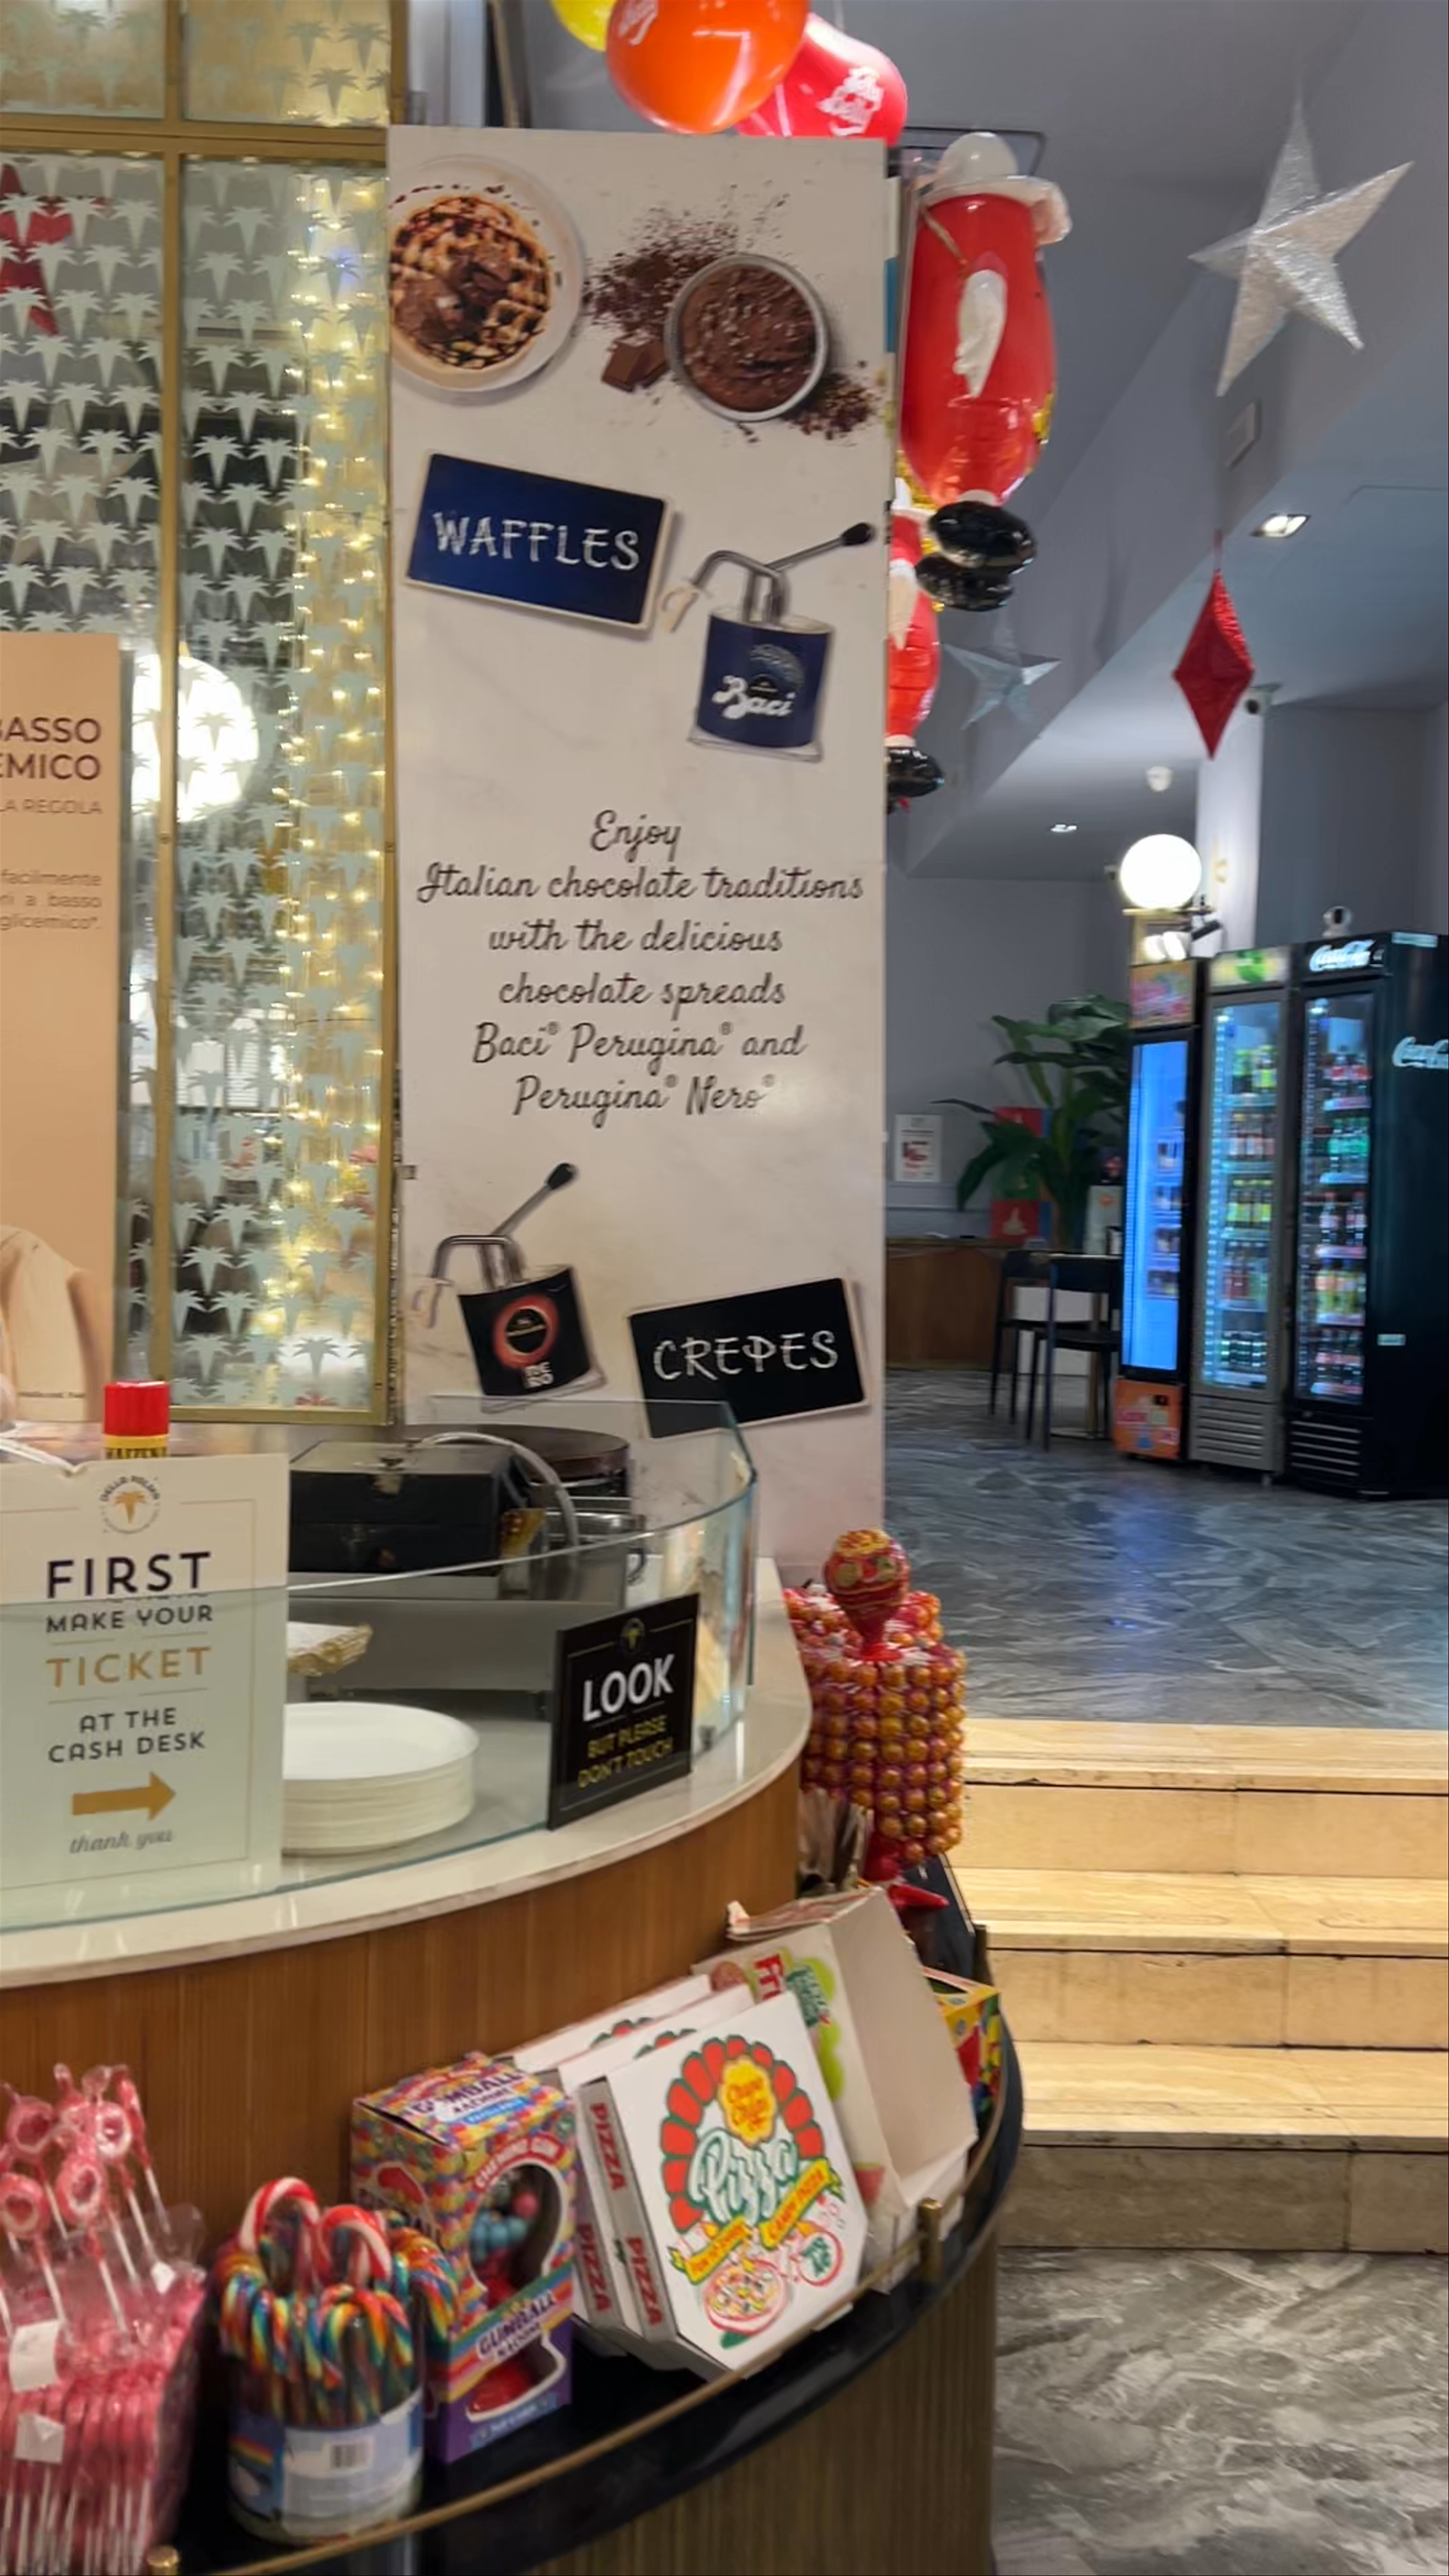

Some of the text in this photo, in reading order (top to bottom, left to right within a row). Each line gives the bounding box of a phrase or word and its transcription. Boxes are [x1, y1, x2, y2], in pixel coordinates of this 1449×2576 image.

[432, 511, 640, 571] WAFFLES
[712, 675, 795, 720] Baci
[0, 716, 102, 743] ASSO
[0, 752, 102, 780] MICO
[590, 810, 681, 863] Enjoy
[416, 862, 864, 904] Italian chocolate traditions
[489, 919, 783, 951] with the delicious
[498, 972, 787, 1021] chocolate spreads
[741, 1024, 809, 1057] and
[653, 1330, 839, 1381] CREPES
[46, 1551, 212, 1599] FIRST
[46, 1604, 213, 1633] MAKE YOUR
[46, 1646, 212, 1688] TICKET
[583, 1653, 675, 1722] LOOK
[80, 1707, 177, 1734] AT THE
[588, 1714, 667, 1759] BUT PLEASE
[48, 1731, 206, 1764] CASH DESK
[626, 1736, 674, 1769] TOUCH
[69, 1829, 174, 1854] thank you
[412, 2072, 524, 2114] GMBALL
[591, 2102, 627, 2192] PIZZA
[689, 2128, 797, 2227] Pizza
[578, 2224, 611, 2312] PIZZA
[627, 2236, 663, 2325] PIZZA
